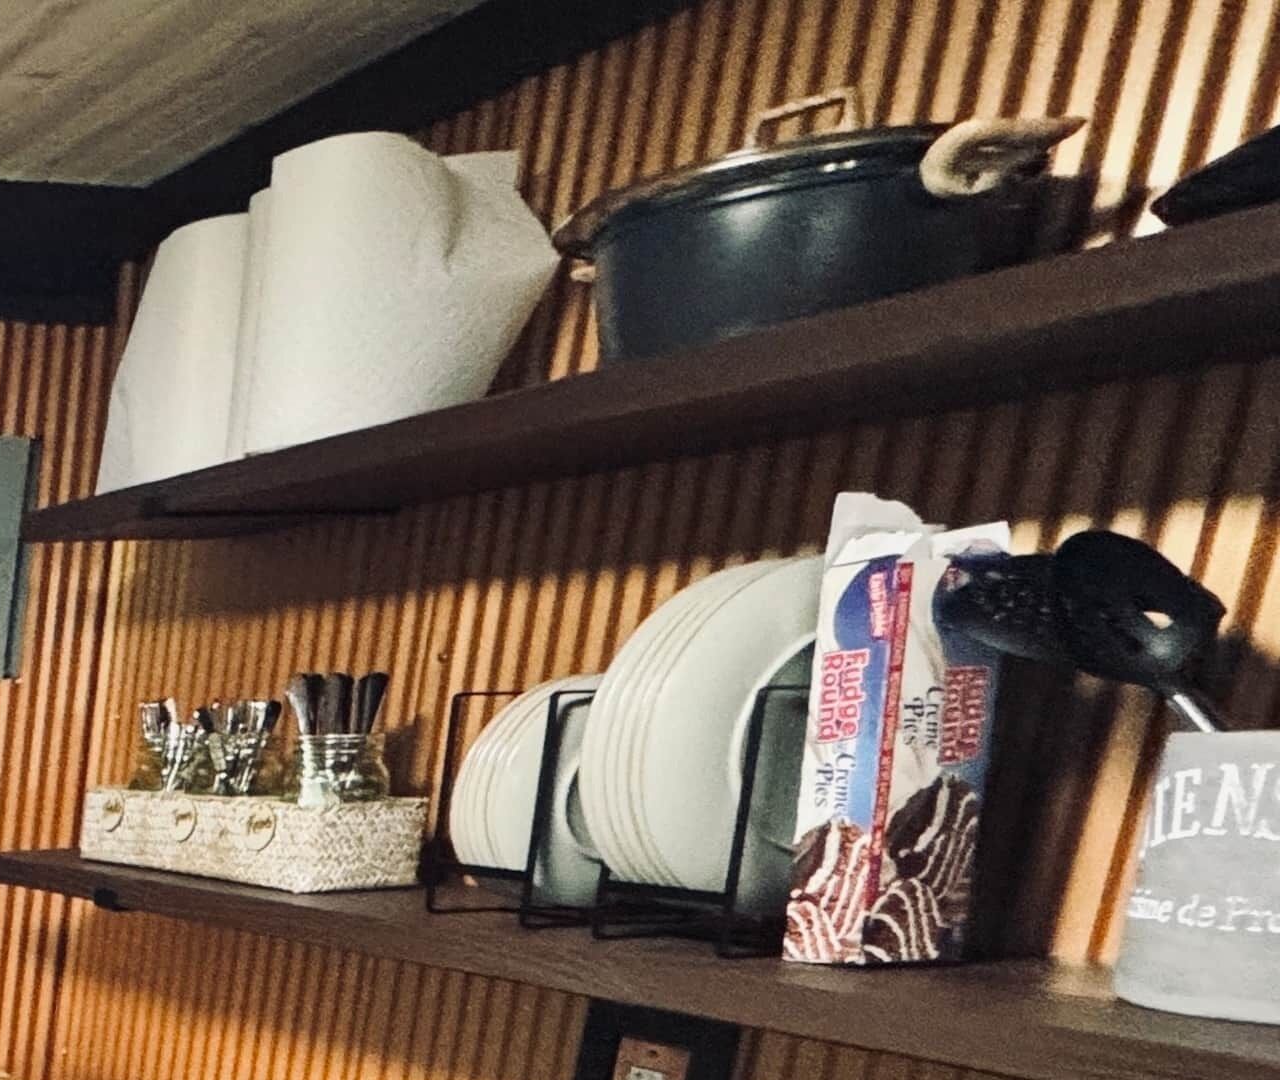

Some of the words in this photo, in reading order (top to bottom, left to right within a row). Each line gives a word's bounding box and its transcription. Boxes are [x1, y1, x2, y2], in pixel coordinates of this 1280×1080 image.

[818, 652, 842, 742] Round
[840, 651, 869, 738] Fudge
[904, 697, 925, 745] Pies
[926, 686, 944, 750] Creme
[939, 668, 965, 764] Round
[815, 761, 835, 808] Pies
[834, 752, 856, 816] Creme
[1177, 894, 1216, 928] de
